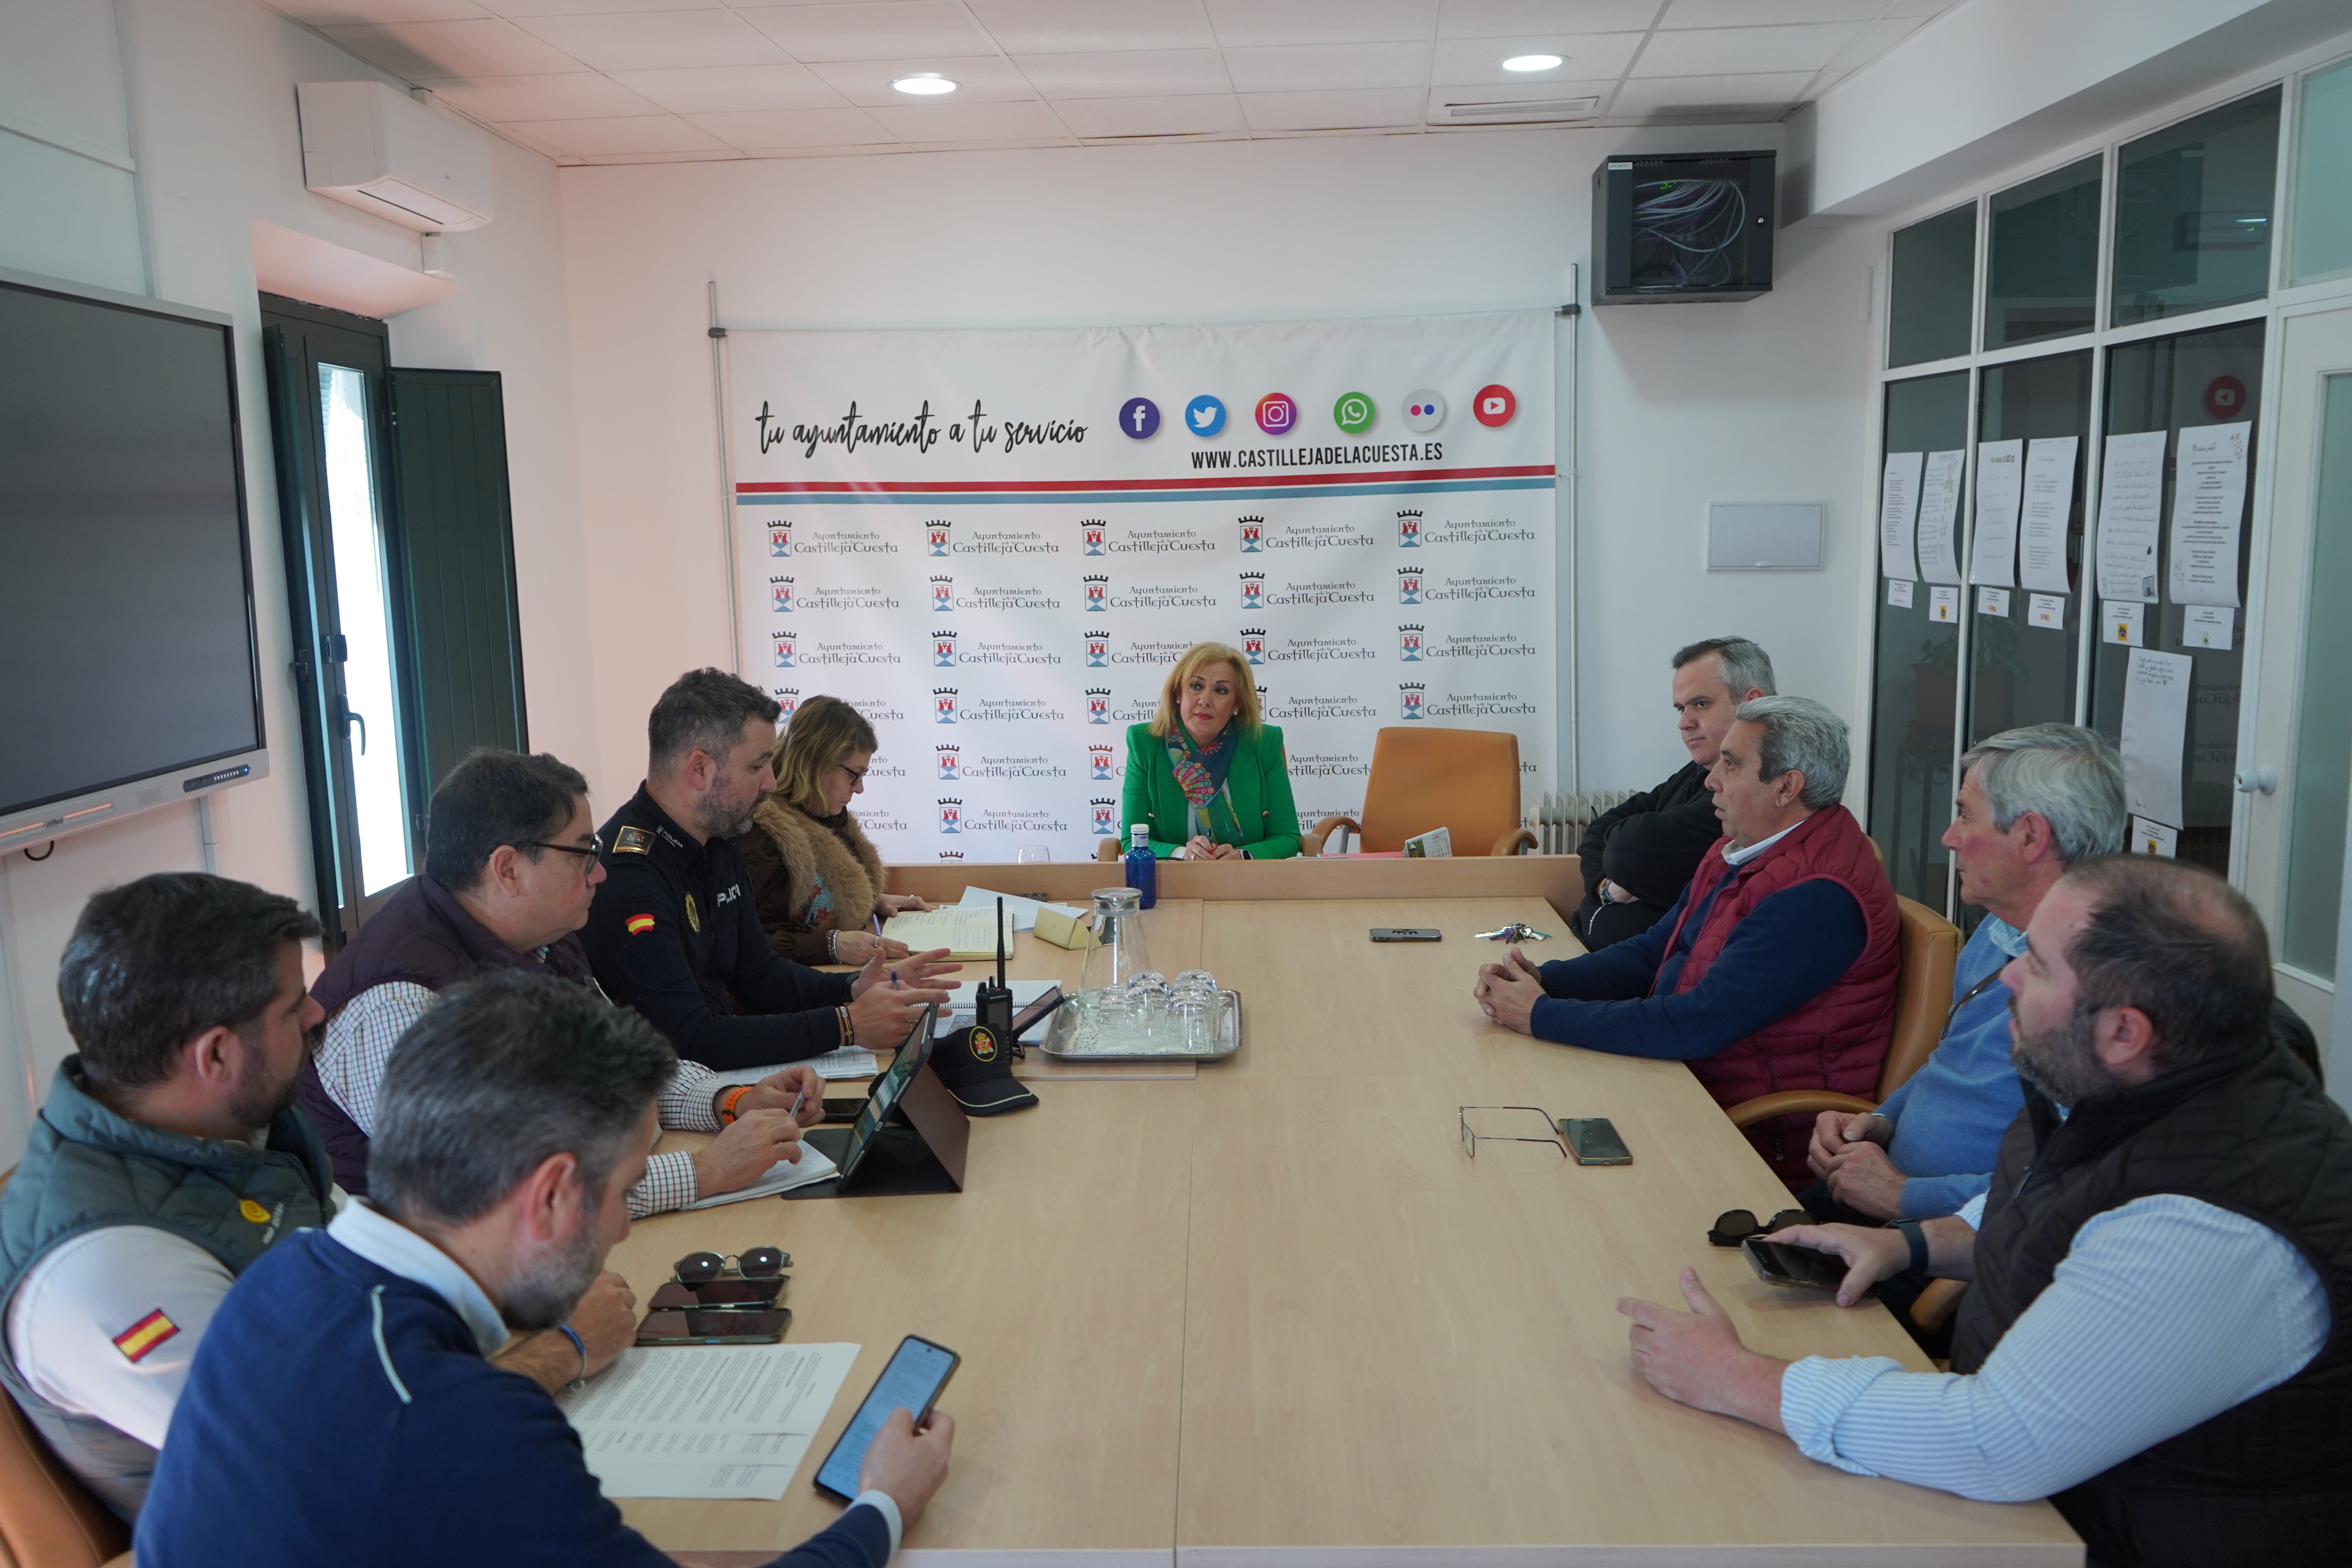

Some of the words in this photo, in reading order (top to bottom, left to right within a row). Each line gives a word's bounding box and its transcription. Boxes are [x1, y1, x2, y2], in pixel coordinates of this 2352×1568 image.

[755, 401, 784, 454] tu
[793, 401, 941, 458] ayuntamiento
[949, 423, 964, 442] a
[968, 399, 997, 453] tu
[1005, 419, 1089, 453] servicio
[1191, 443, 1443, 468] WWW.CASTILLEJADELACUESTA.ES
[1445, 519, 1515, 530] Ayuntamiento
[1127, 530, 1196, 540] Ayuntamiento
[1285, 524, 1355, 536] Ayuntamiento
[813, 532, 880, 541] Ayuntamiento
[972, 532, 1040, 542] Ayuntamiento
[1286, 581, 1355, 593] Ayuntamiento
[1445, 576, 1516, 588] Ayuntamiento
[815, 587, 880, 597] Ayuntamiento
[973, 587, 1042, 597] Ayuntamiento
[1129, 585, 1198, 596] Ayuntamiento
[1287, 638, 1356, 648] Ayuntamiento
[1446, 634, 1516, 645] Ayuntamiento
[817, 642, 882, 652] Ayuntamiento
[978, 642, 1042, 652] Ayuntamiento
[1131, 642, 1194, 652] Ayuntamient
[1288, 696, 1357, 706] Ayuntamiento
[1446, 692, 1517, 703] Ayuntamiento
[979, 699, 1046, 708] Ayuntamiento
[1113, 710, 1154, 721] Castill
[980, 756, 1048, 766] Ayuntamiento
[1290, 754, 1358, 764] Ayuntamiento
[1289, 765, 1331, 778] stilleja
[1332, 764, 1370, 776] Cuest
[983, 809, 1049, 819] Ayuntamiento
[1297, 809, 1359, 819] yuntamiento
